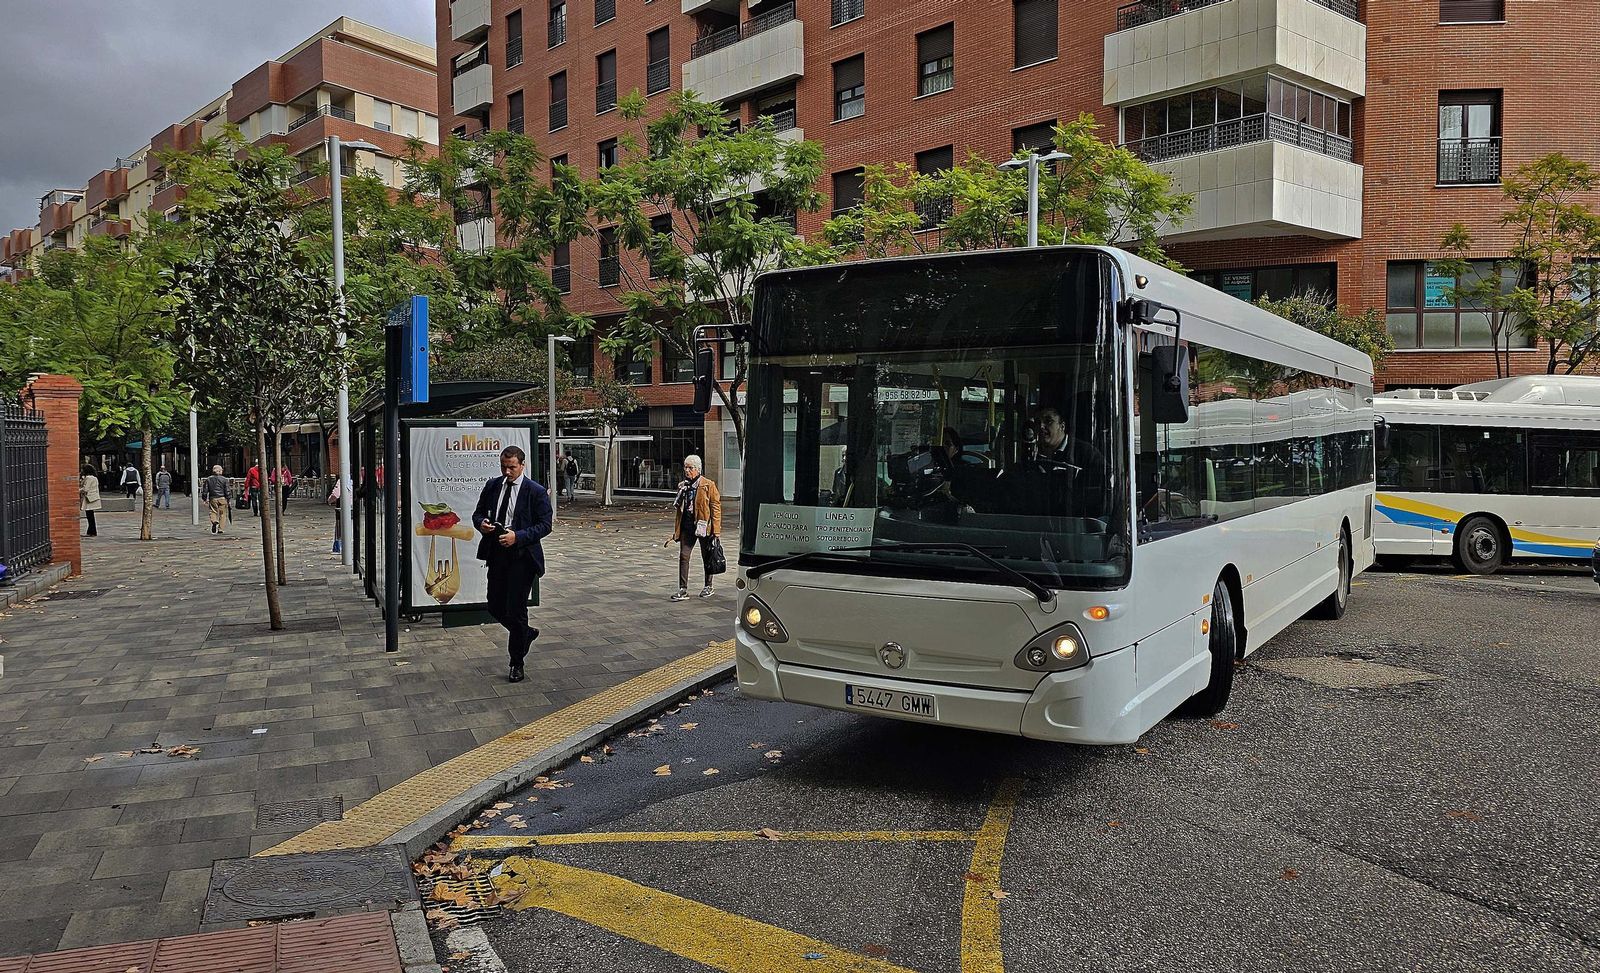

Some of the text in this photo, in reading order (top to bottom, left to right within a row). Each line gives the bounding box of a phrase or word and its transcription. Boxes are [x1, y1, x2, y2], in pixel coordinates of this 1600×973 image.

[900, 390, 908, 400] 58
[446, 434, 500, 451] LaMafia
[825, 512, 848, 520] LÍNEA
[858, 689, 930, 714] 5447 GMW
